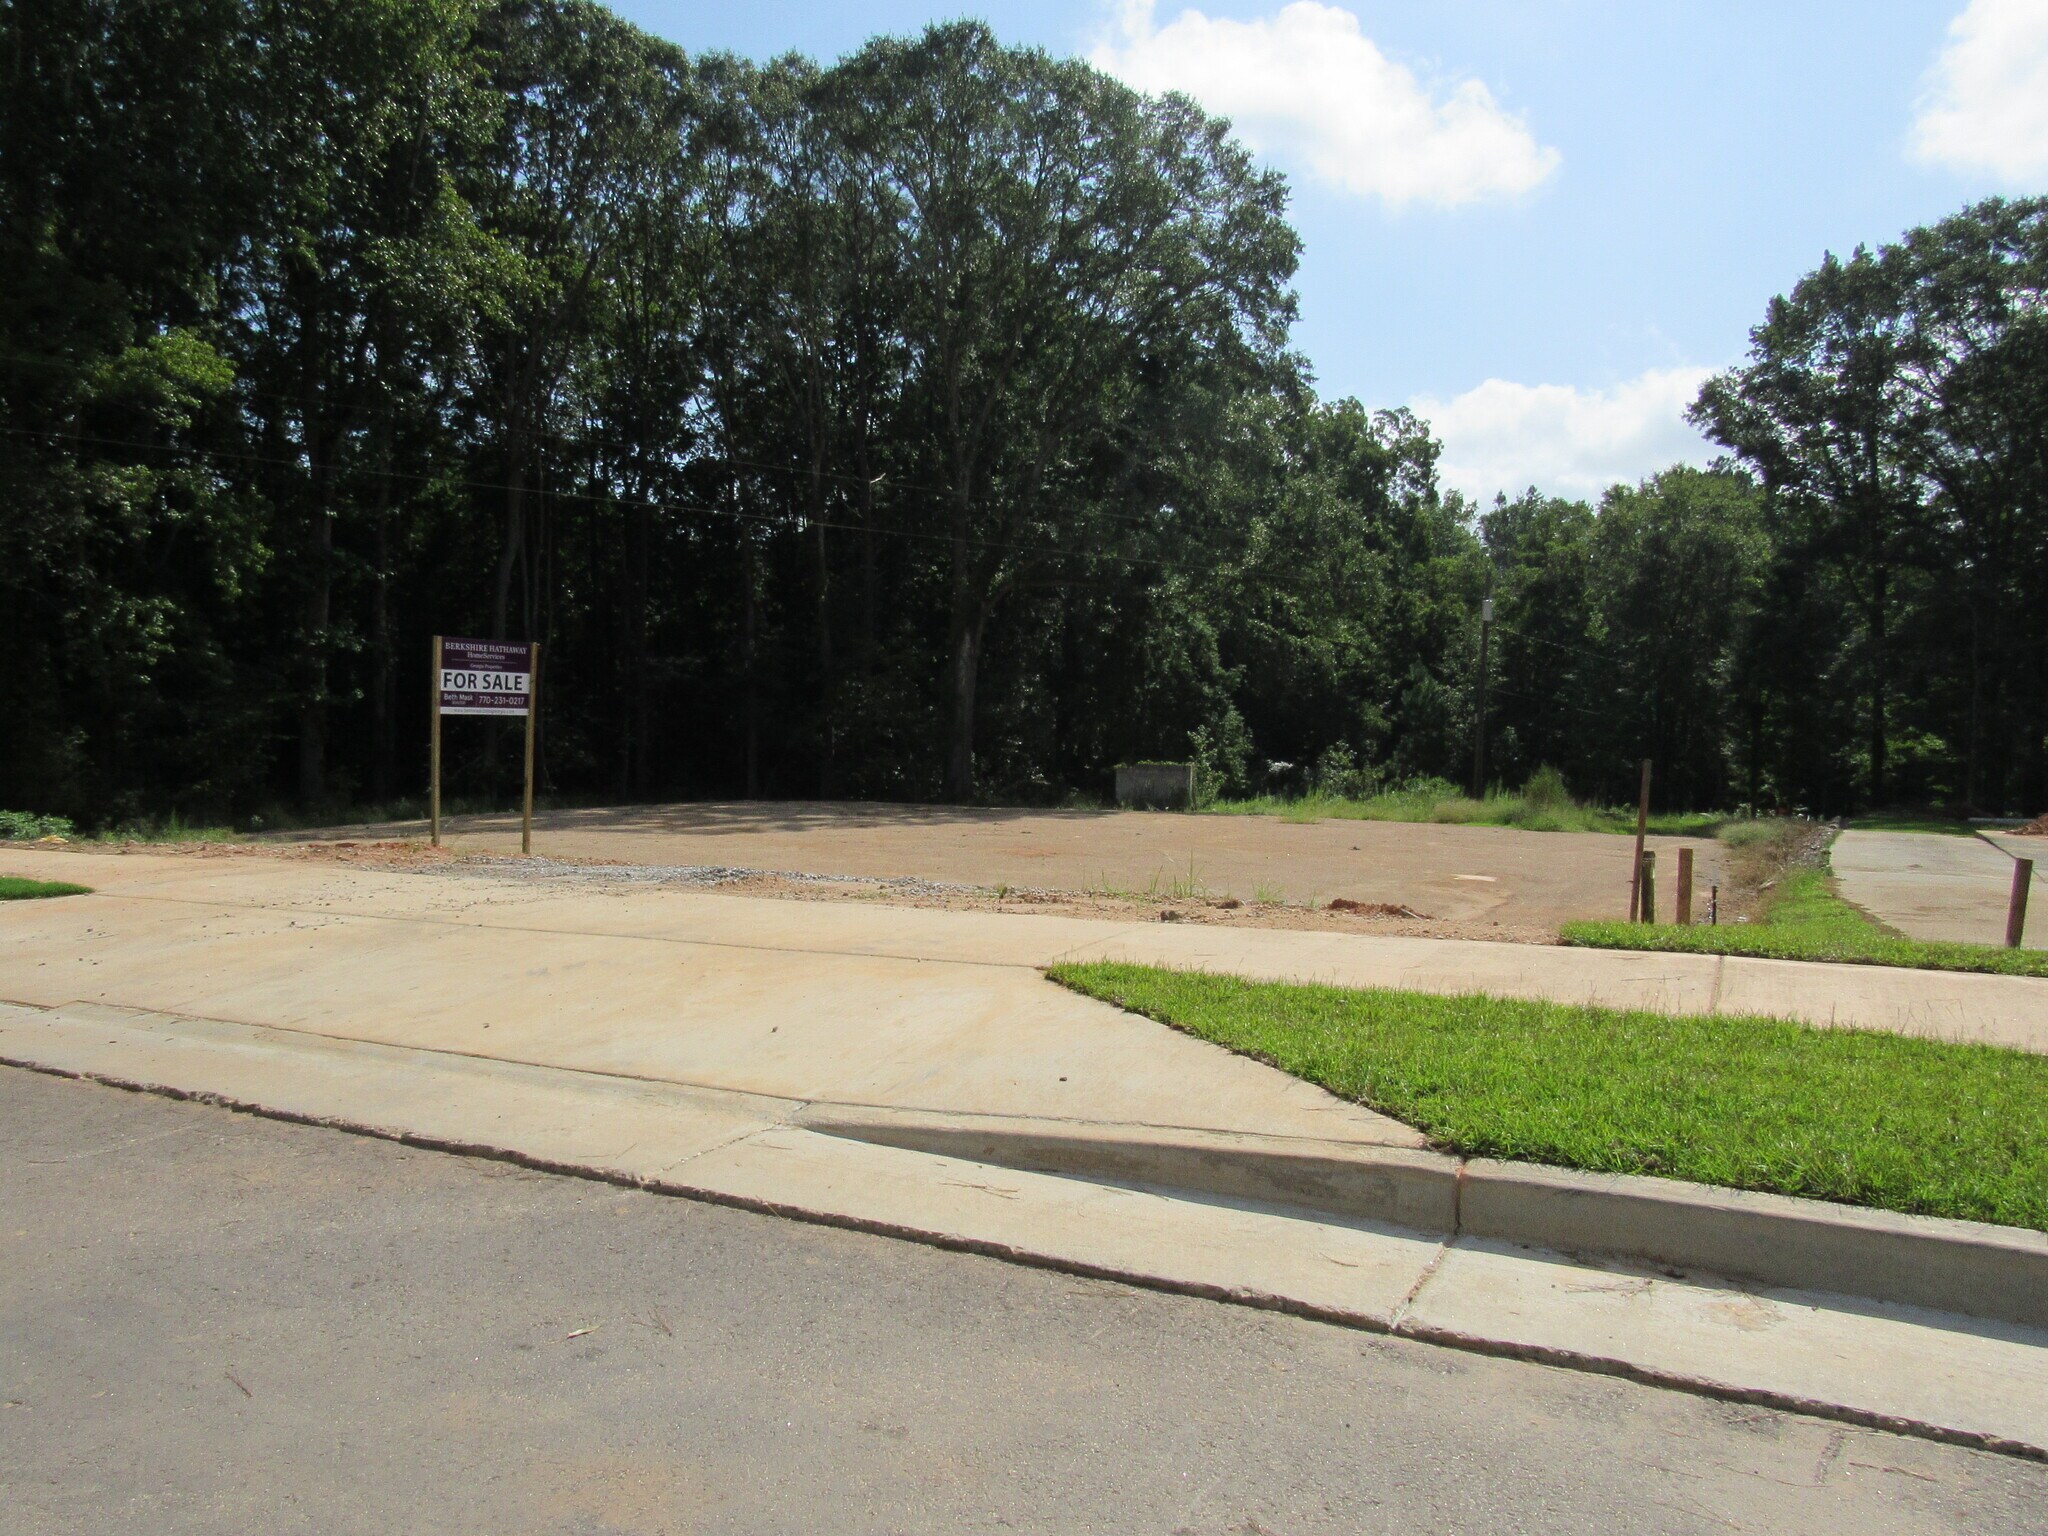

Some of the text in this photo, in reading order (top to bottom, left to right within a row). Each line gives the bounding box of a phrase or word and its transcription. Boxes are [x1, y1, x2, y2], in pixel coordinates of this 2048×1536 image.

[445, 642, 527, 654] BERKSHIRE HATHAWAY
[443, 672, 522, 691] FOR SALE
[443, 693, 459, 701] Beth
[479, 696, 525, 705] 770-231-0217
